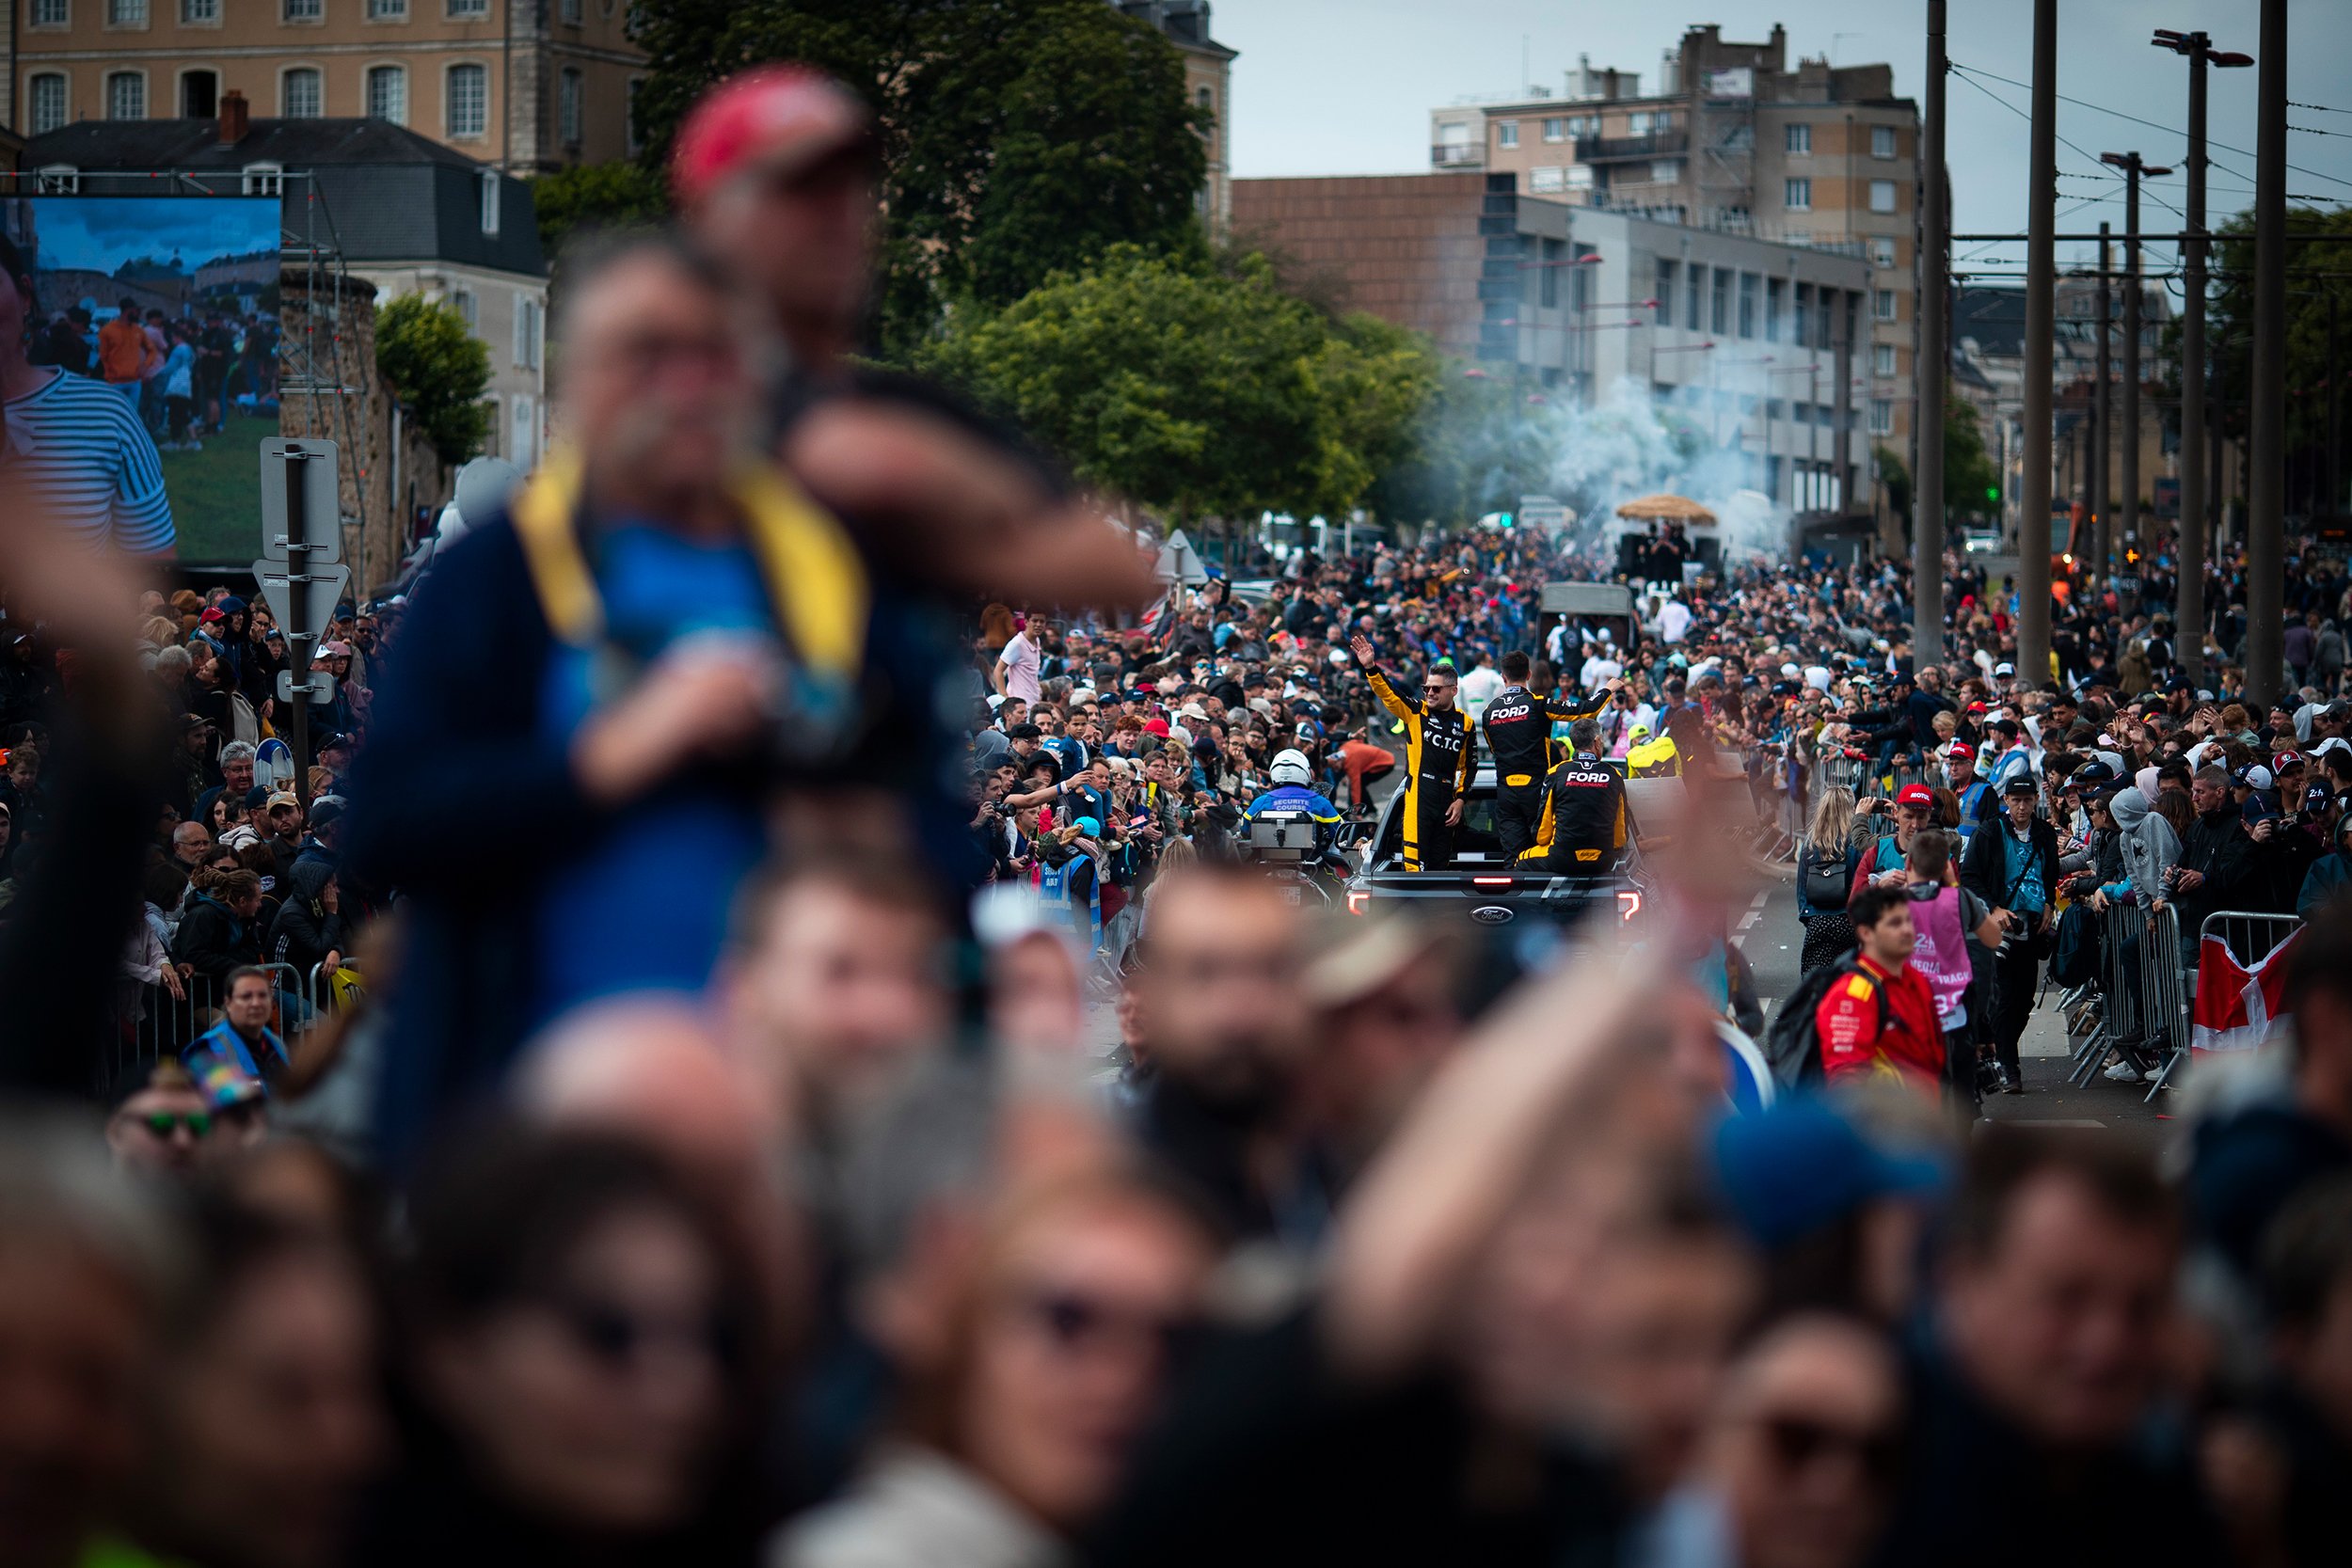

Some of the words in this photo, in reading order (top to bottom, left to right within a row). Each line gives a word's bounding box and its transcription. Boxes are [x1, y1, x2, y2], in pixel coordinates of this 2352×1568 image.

[1490, 705, 1530, 721] FORD
[1489, 715, 1529, 726] PERFORMANCE
[1566, 771, 1611, 784] FORD
[1565, 781, 1609, 789] PERFORMANCE
[1910, 792, 1931, 801] MOTUL
[1481, 909, 1504, 920] Ford
[1937, 972, 1970, 985] TRACK
